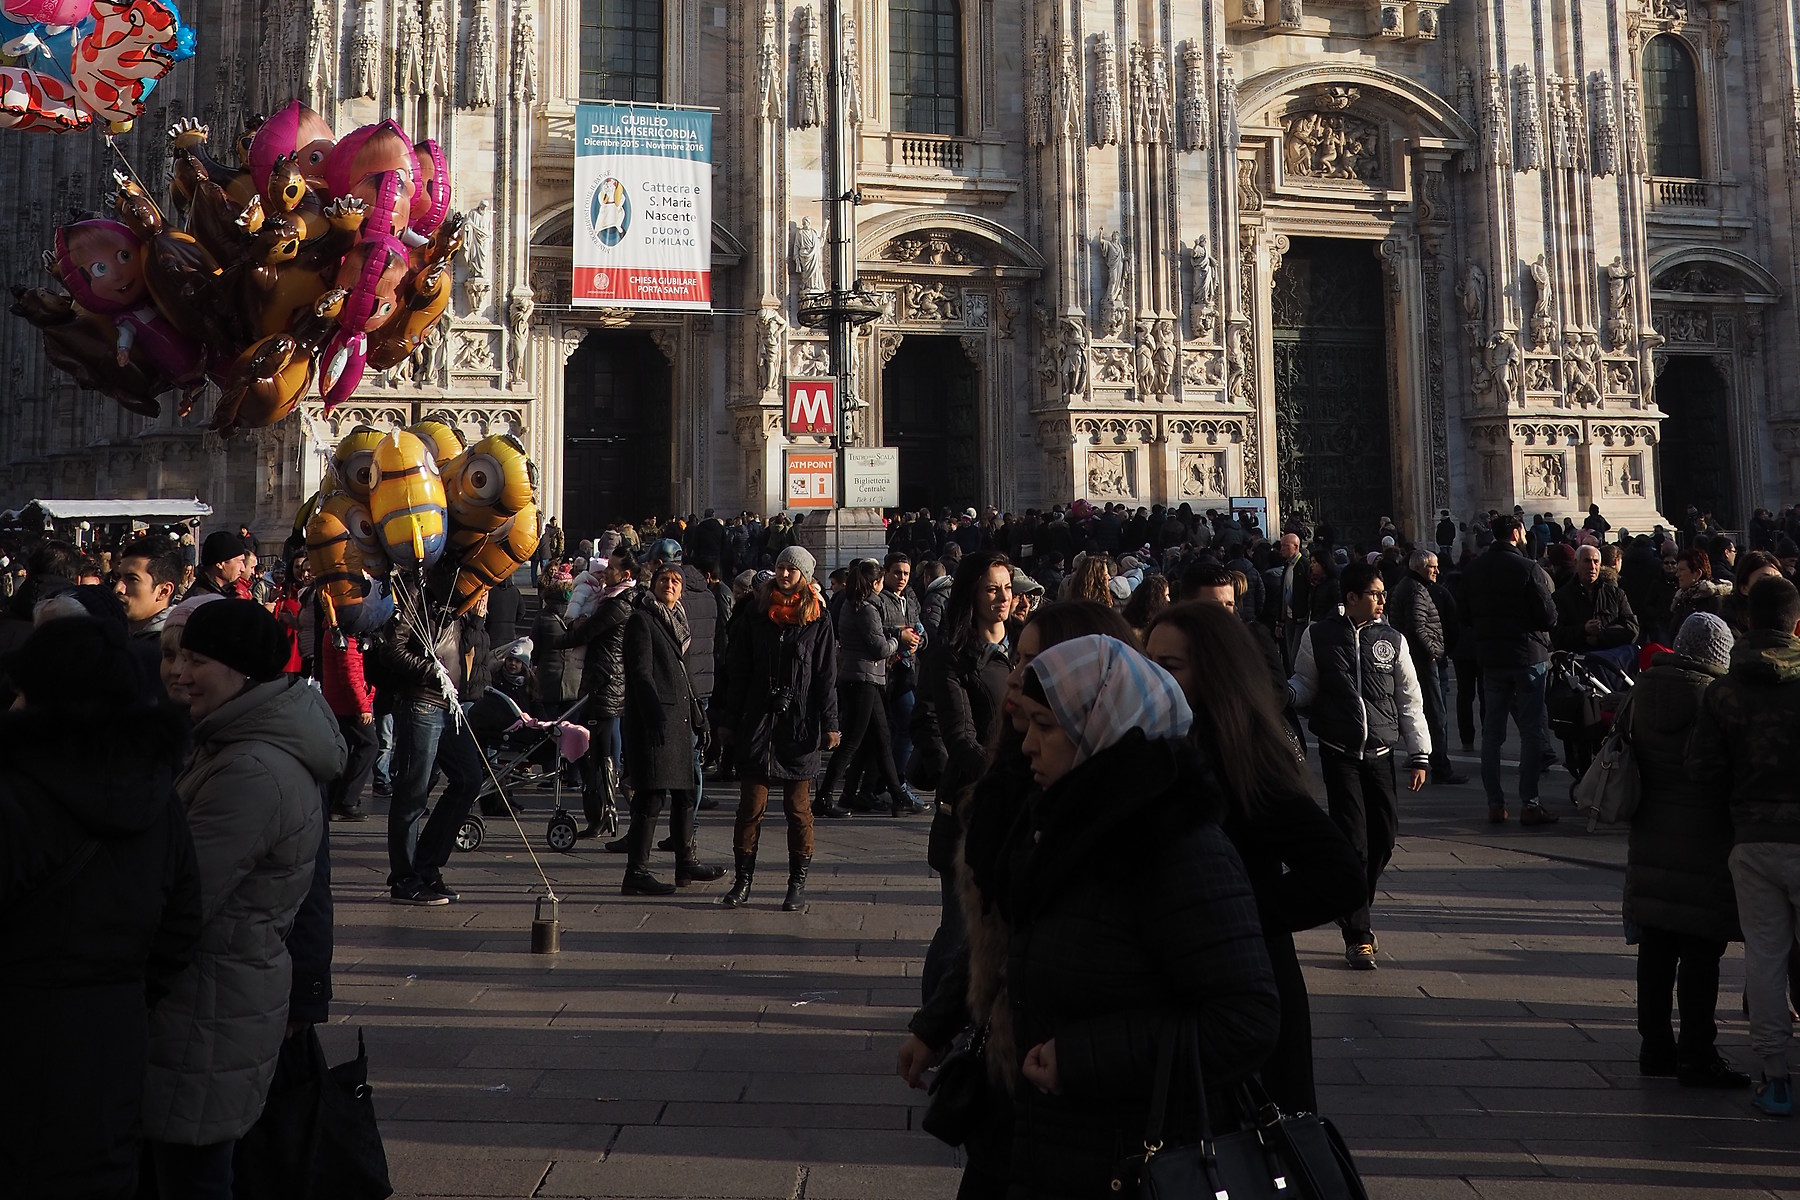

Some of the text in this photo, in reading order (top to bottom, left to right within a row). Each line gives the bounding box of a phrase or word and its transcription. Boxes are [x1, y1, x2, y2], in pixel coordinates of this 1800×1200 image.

[621, 115, 668, 127] GIUBILEO
[591, 124, 697, 140] DELLA MISERICORDIA
[584, 138, 620, 147] Dicembre
[621, 140, 640, 148] 2015
[646, 141, 684, 151] Novembre
[685, 143, 704, 152] 2016
[649, 196, 692, 208] S. Maria
[645, 210, 697, 222] Nascente
[652, 227, 690, 236] DUOMO
[645, 237, 696, 247] DI MILANO
[629, 276, 697, 286] CHIESA GIUBILARE
[637, 285, 689, 295] PORTA SANTA
[790, 389, 832, 424] M
[789, 461, 833, 469] ATM POINT
[854, 477, 891, 486] Biglietteria
[858, 485, 886, 493] Centrale
